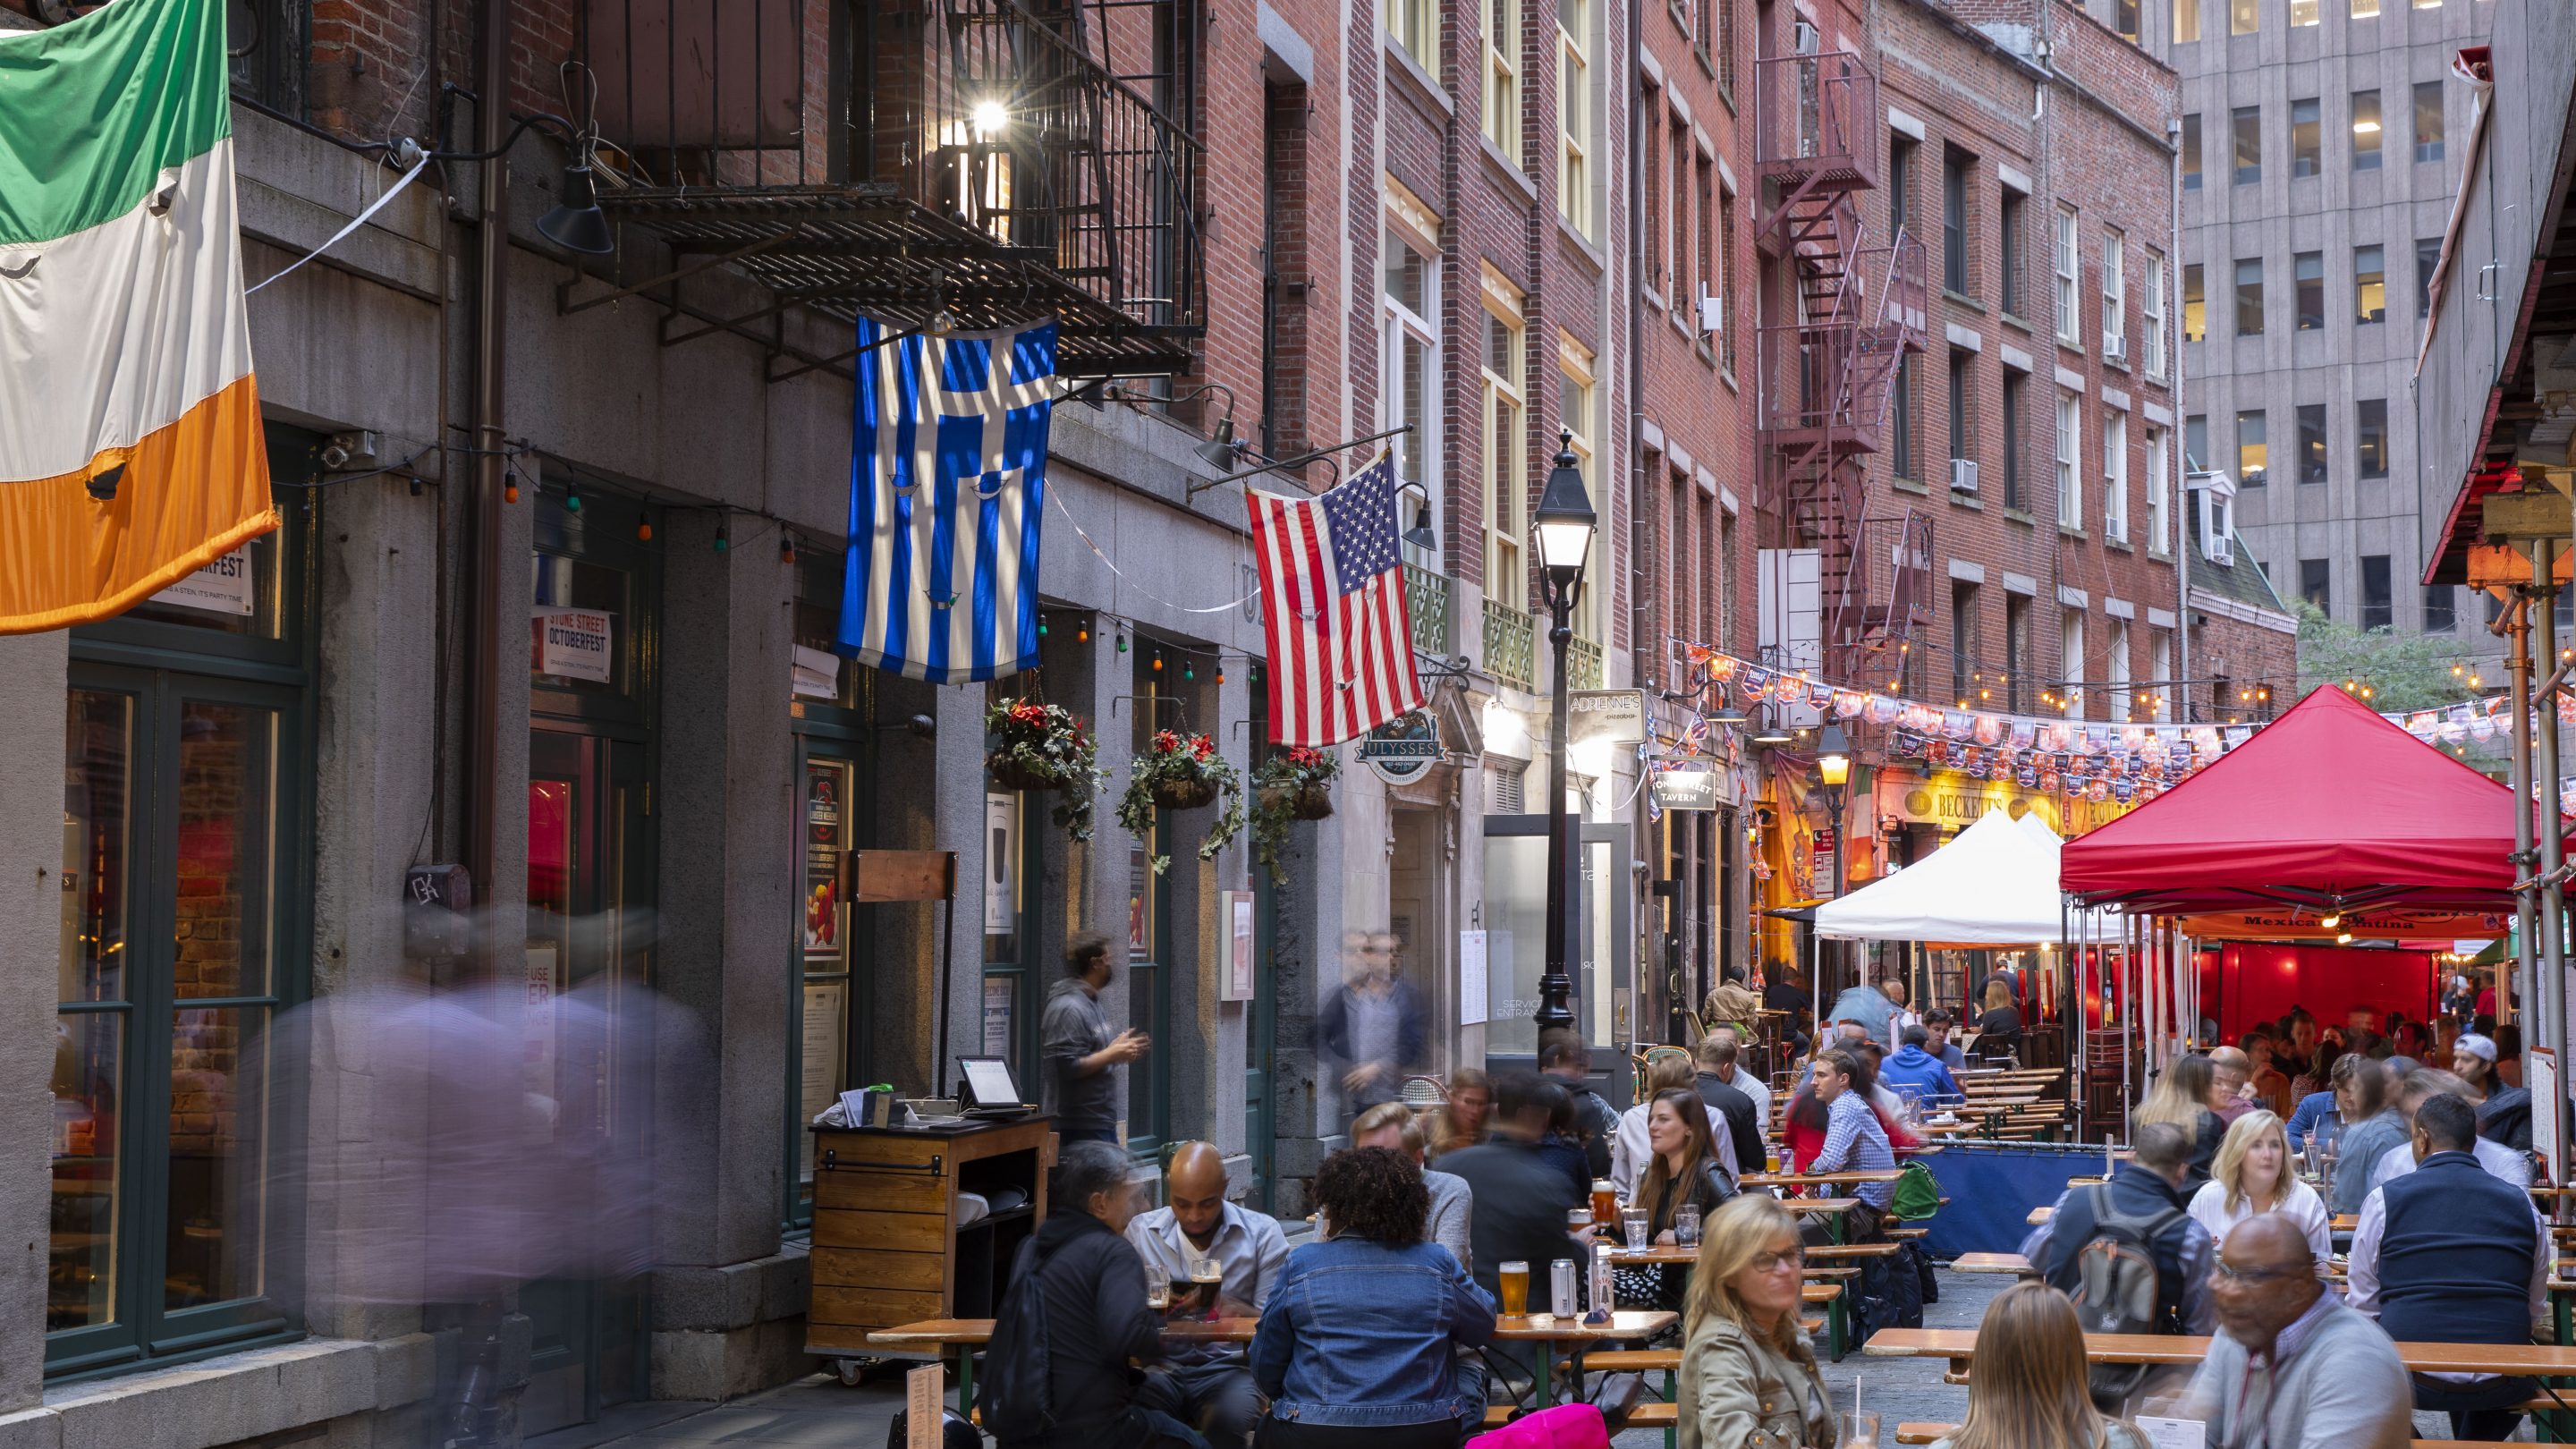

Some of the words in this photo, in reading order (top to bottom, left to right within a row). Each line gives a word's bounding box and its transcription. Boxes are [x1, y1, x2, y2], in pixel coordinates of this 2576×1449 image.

[209, 592, 227, 600] PARTY
[228, 595, 242, 603] TIME
[550, 614, 574, 628] STONE
[577, 614, 606, 634] STREET
[549, 627, 606, 653] OCTOBERFEST
[1571, 696, 1640, 711] ADRIENNE'S
[1367, 742, 1437, 755] ULYSSES'
[1379, 770, 1394, 781] PEARL
[1394, 775, 1414, 783] STREET
[1680, 779, 1713, 794] TREET
[1660, 792, 1697, 802] TAVERN
[1938, 794, 2002, 818] BECKETT'S
[530, 967, 548, 981] USE
[1496, 1008, 1538, 1017] ENTRAN
